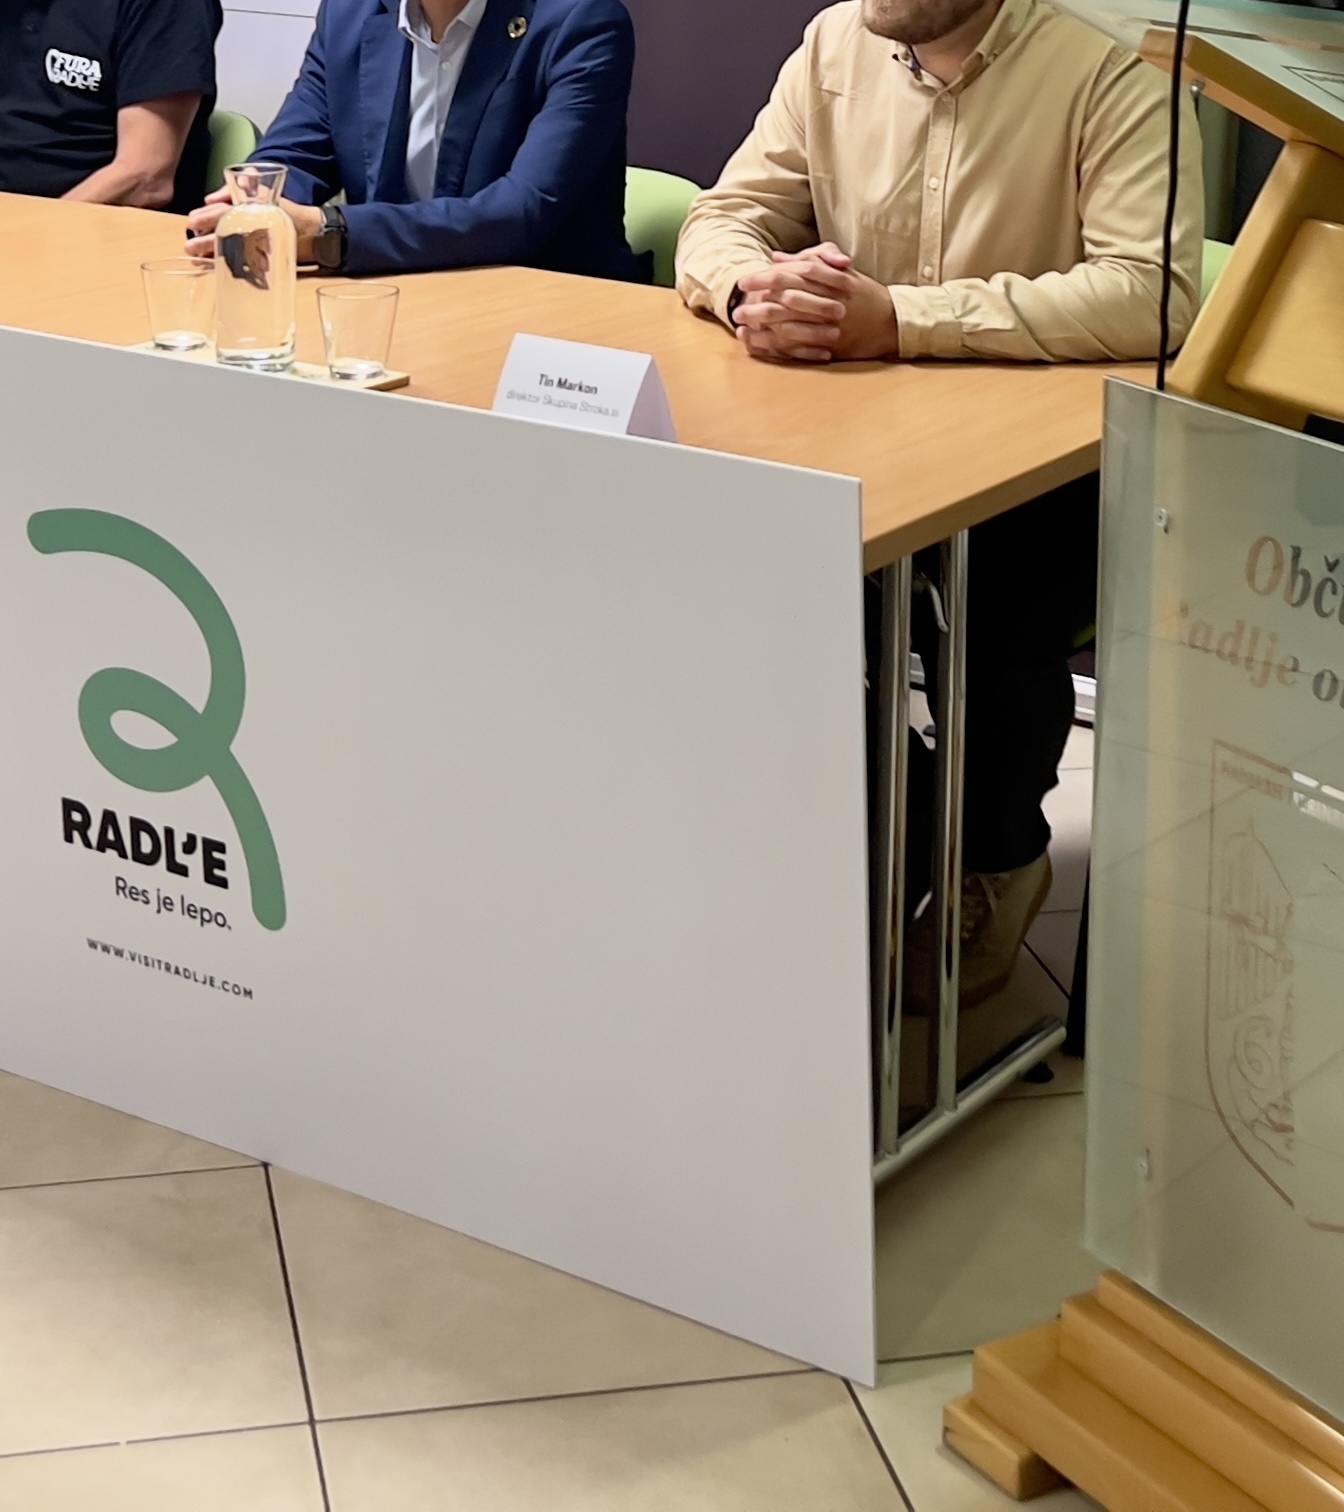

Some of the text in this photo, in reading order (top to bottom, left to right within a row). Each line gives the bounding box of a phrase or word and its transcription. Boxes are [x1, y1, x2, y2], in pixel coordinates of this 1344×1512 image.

[53, 51, 102, 78] FURA
[539, 373, 554, 387] Tin
[1180, 599, 1300, 688] adlje
[115, 876, 232, 931] Res je lepo.
[86, 938, 254, 1000] WWW.VISITRADLJE.COM
